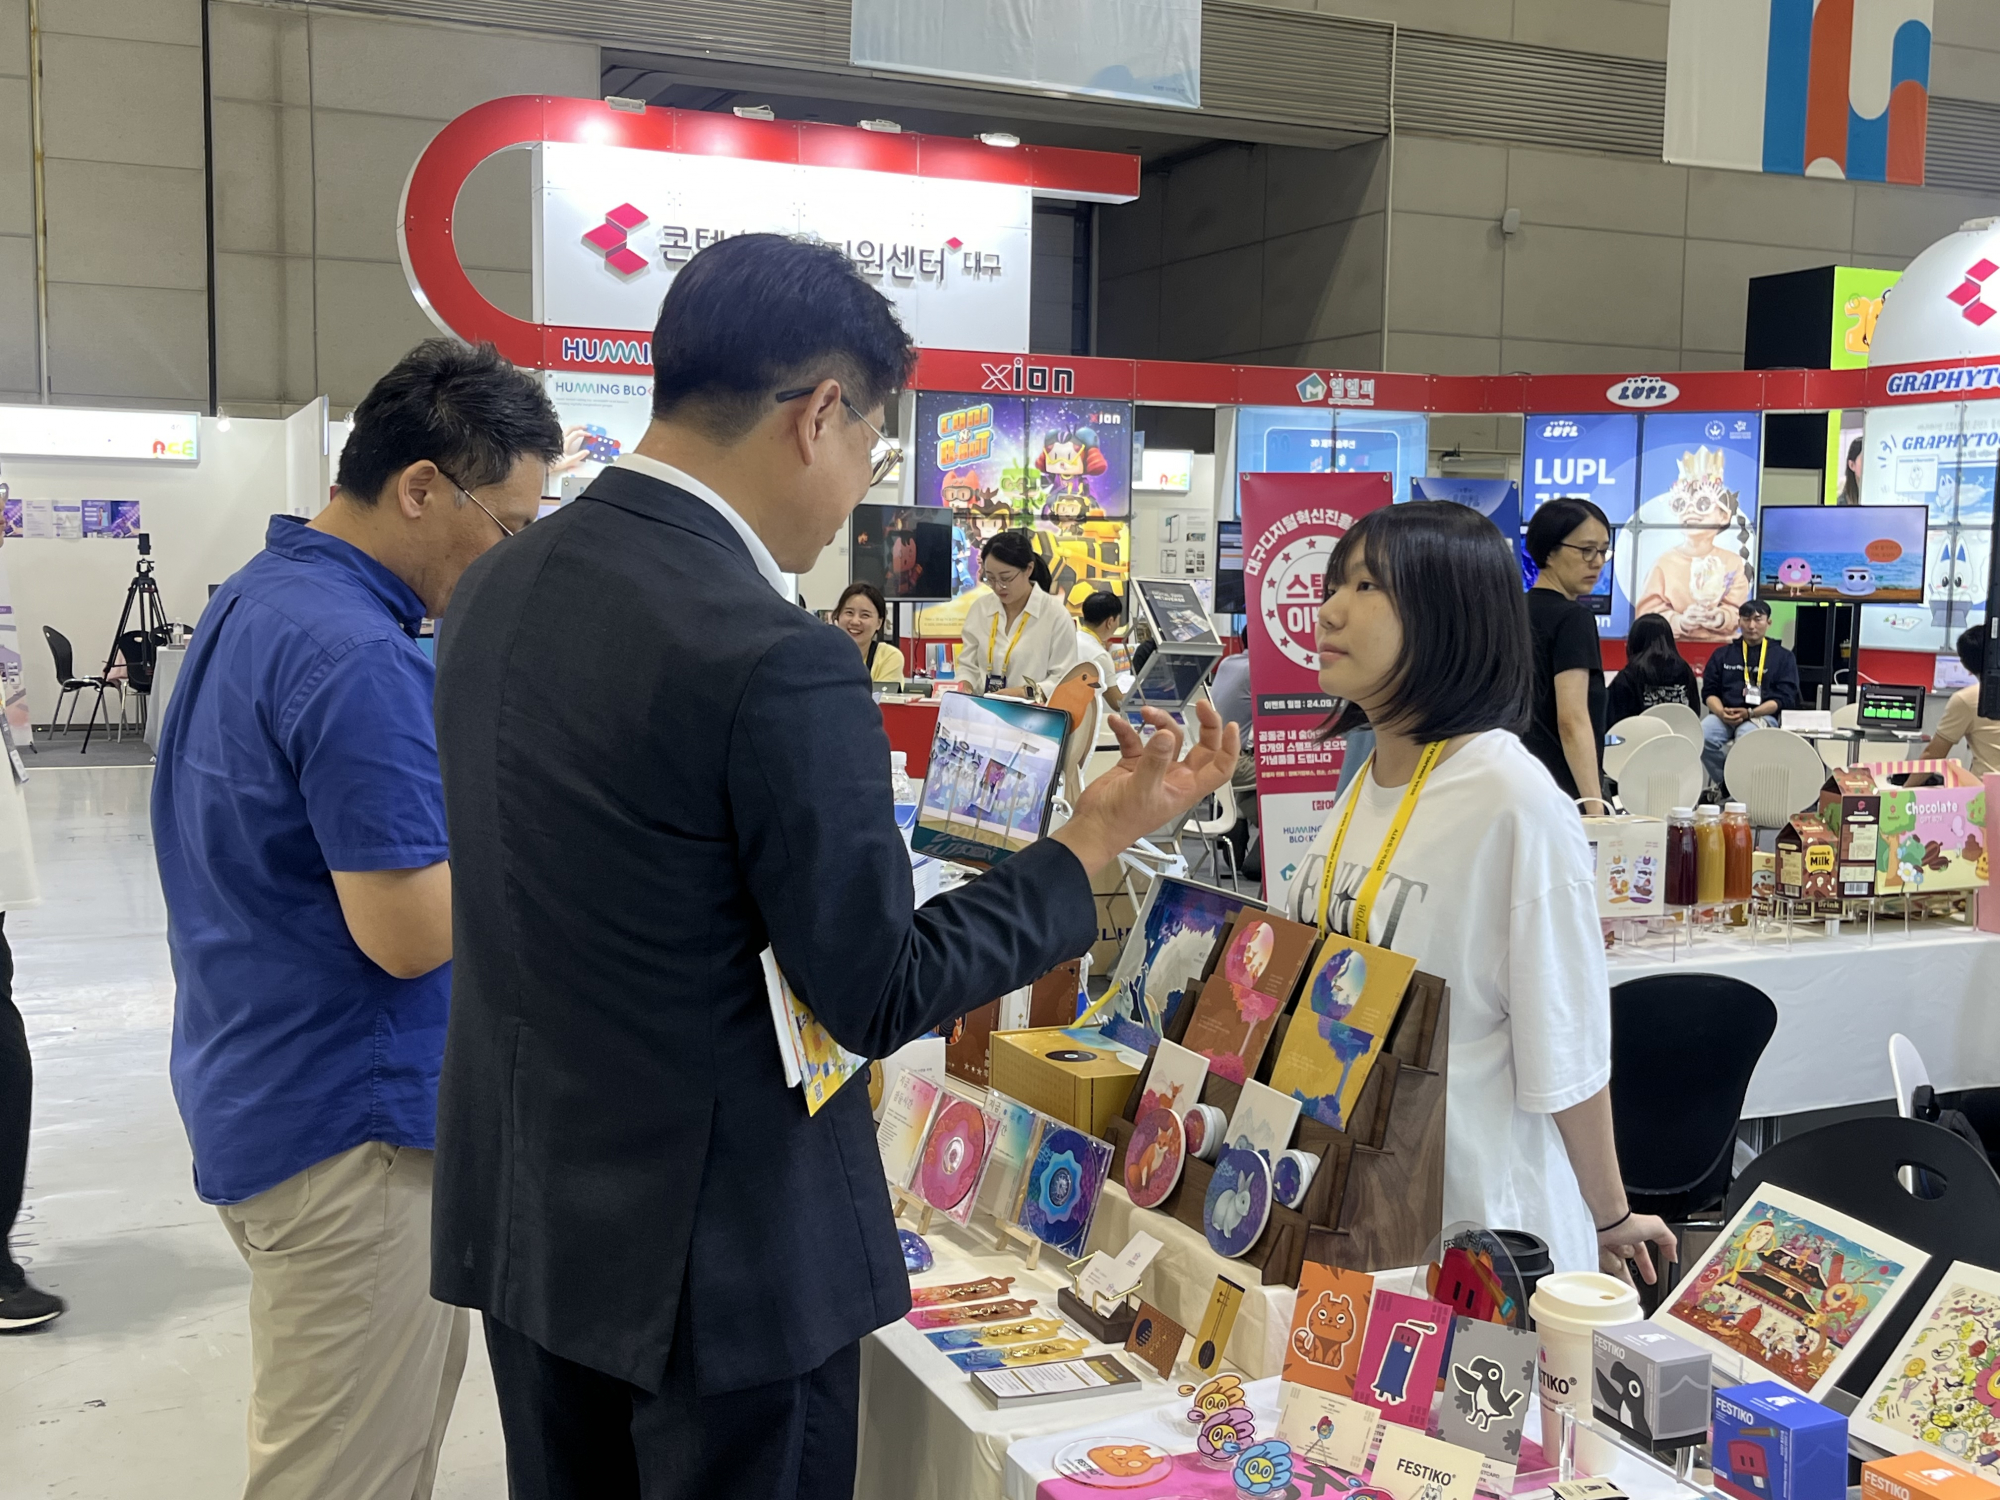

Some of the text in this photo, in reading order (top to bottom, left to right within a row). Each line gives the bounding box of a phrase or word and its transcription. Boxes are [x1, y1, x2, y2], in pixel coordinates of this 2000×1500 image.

[963, 252, 1001, 276] 대구
[563, 338, 653, 363] HUMMI
[981, 357, 1074, 393] xion
[1618, 385, 1667, 400] LUPL
[1902, 431, 2000, 451] GRAPHYTO
[1534, 458, 1616, 485] LUPL
[1245, 508, 1359, 577] 대구디지털혁신진흥
[1298, 753, 1332, 764] 드립니다
[1905, 801, 1958, 815] Chocolate
[1810, 857, 1830, 866] Milk
[1594, 1334, 1625, 1360] FESTIKO
[1716, 1397, 1754, 1426] FESTIKO
[1864, 1470, 1910, 1500] FESTIKO
